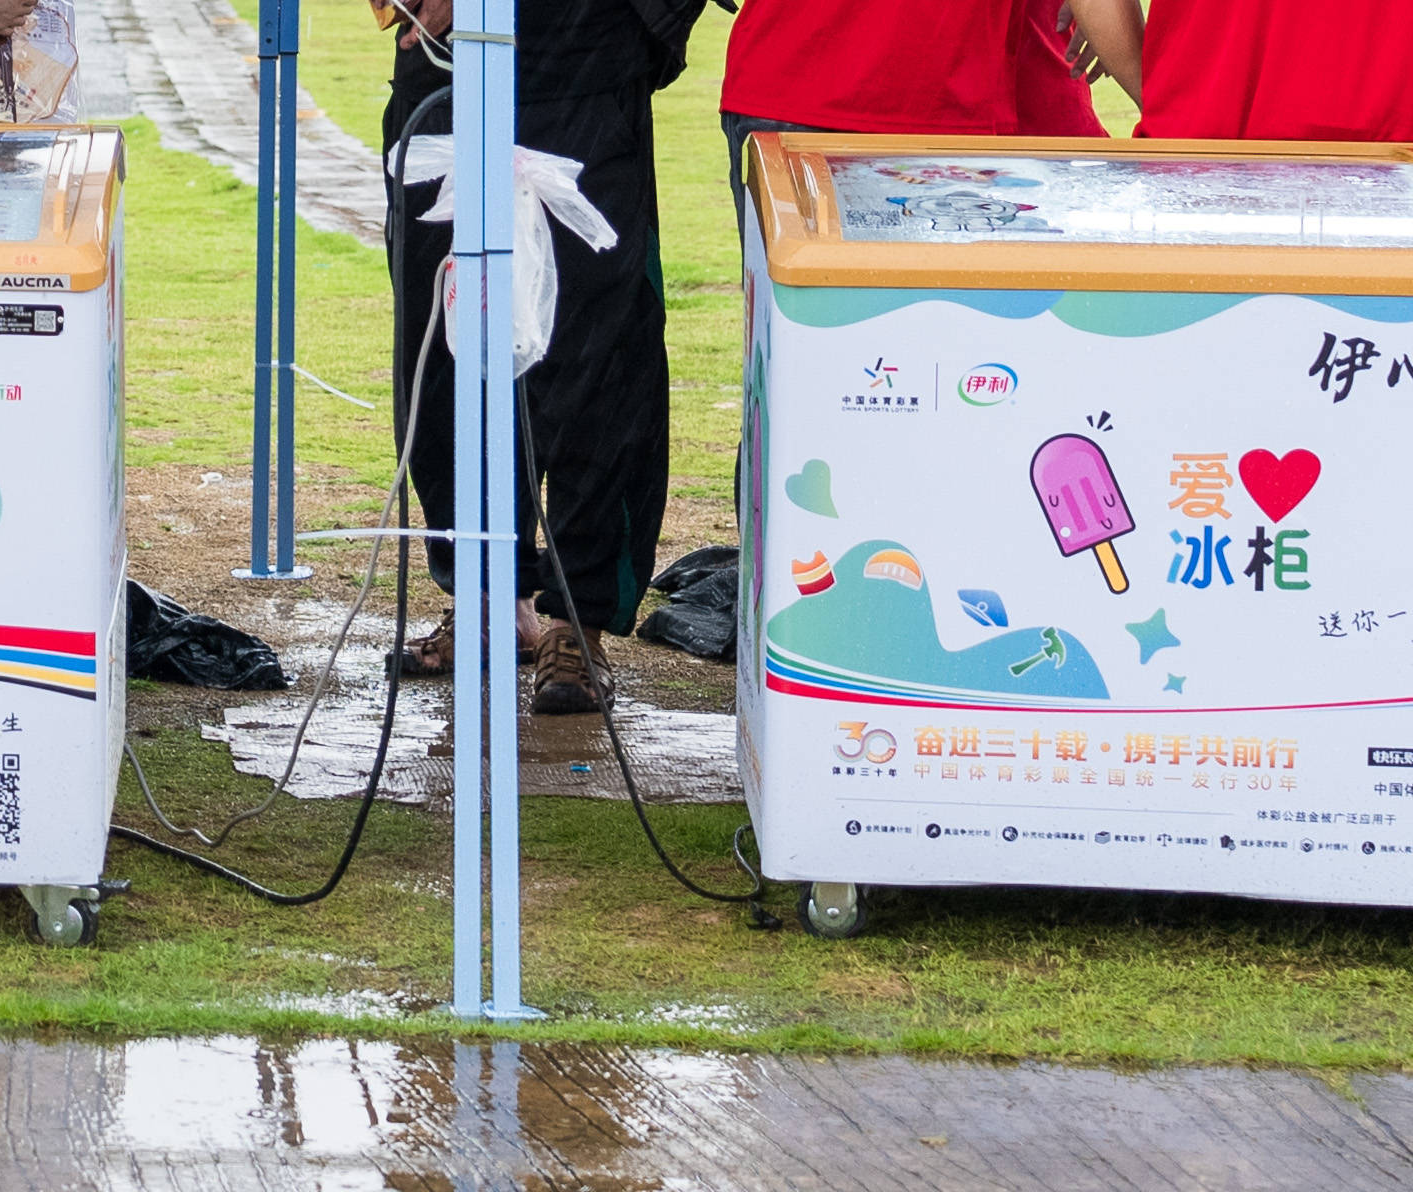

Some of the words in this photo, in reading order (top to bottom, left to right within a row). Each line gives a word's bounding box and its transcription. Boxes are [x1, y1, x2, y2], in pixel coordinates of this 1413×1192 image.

[1, 277, 64, 288] AUCMA
[966, 375, 1009, 393] 伊利
[842, 395, 919, 406] 中国体育彩票
[1168, 452, 1233, 521] 爱
[1167, 524, 1312, 592] 冰柜
[914, 761, 1298, 793] 中国体育彩票全国统一发行30年
[1256, 809, 1397, 827] 体彩公益金被广泛应用于
